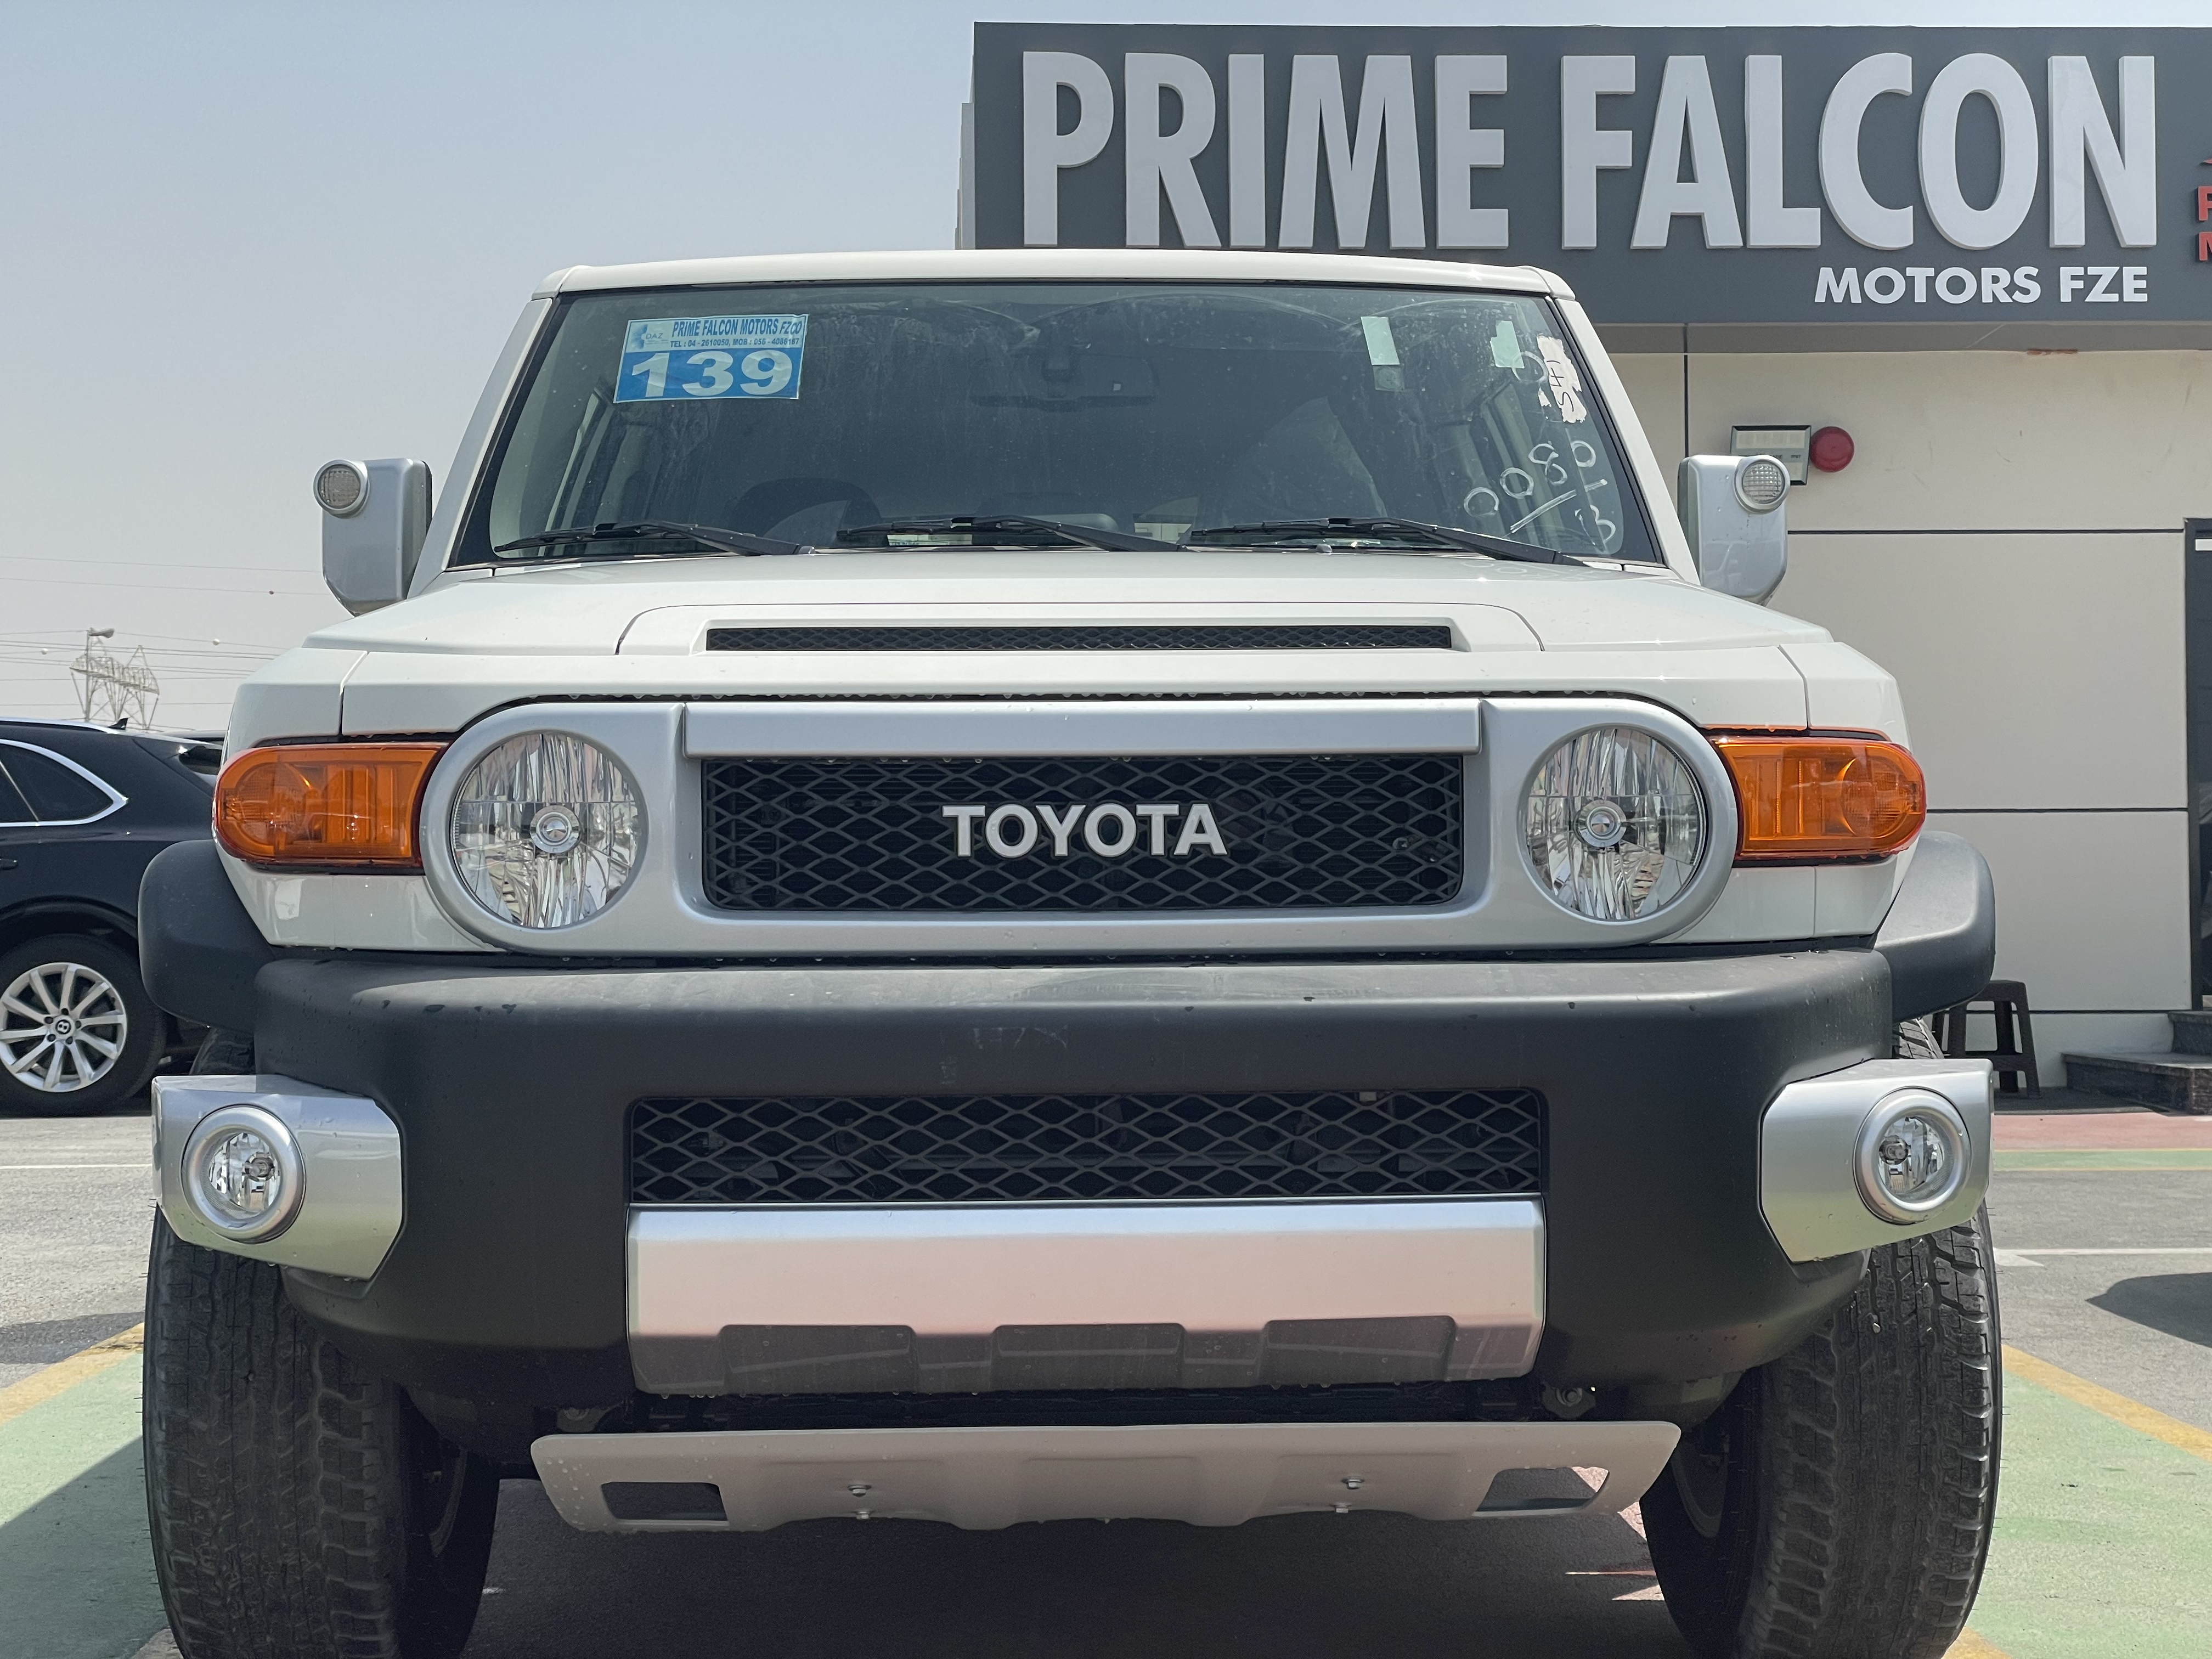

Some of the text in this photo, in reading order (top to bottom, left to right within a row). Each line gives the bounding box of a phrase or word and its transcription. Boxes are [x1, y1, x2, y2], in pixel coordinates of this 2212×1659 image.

[1023, 50, 2157, 250] PRIME FALCON
[1814, 266, 2148, 304] MOTORS FZE
[672, 318, 803, 337] PRIME FALCON MOTORS FZCO
[631, 349, 793, 397] 139
[942, 803, 1228, 858] TOYOTA
